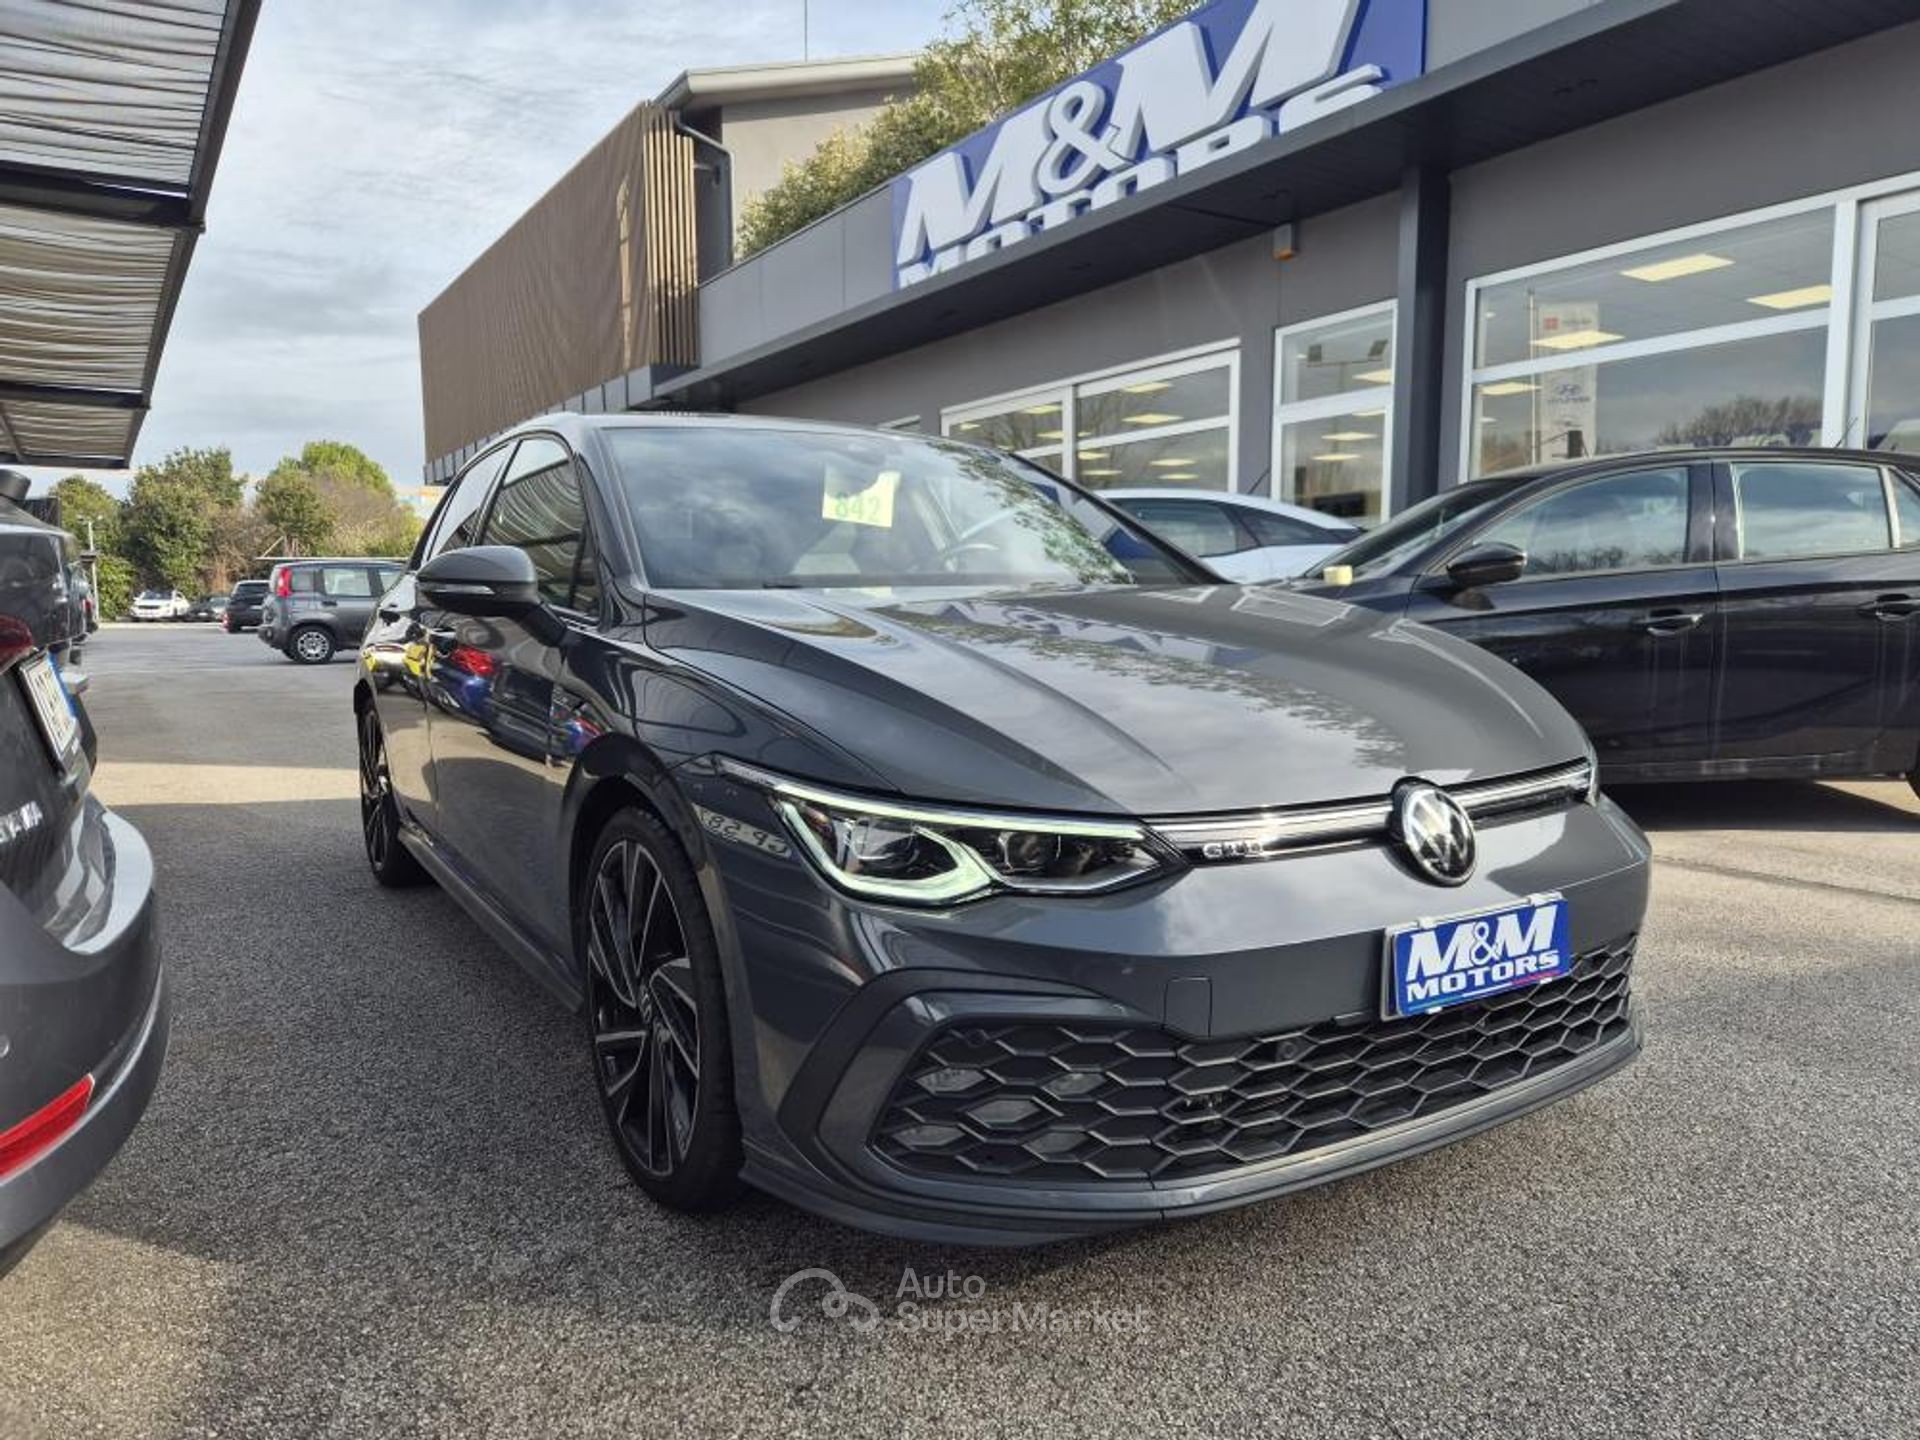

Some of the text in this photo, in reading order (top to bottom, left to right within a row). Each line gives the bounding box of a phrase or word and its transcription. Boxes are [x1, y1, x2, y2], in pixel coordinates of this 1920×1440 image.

[897, 0, 1362, 266] M&M
[1406, 904, 1558, 982] M&M
[1406, 950, 1560, 1002] MOTORS
